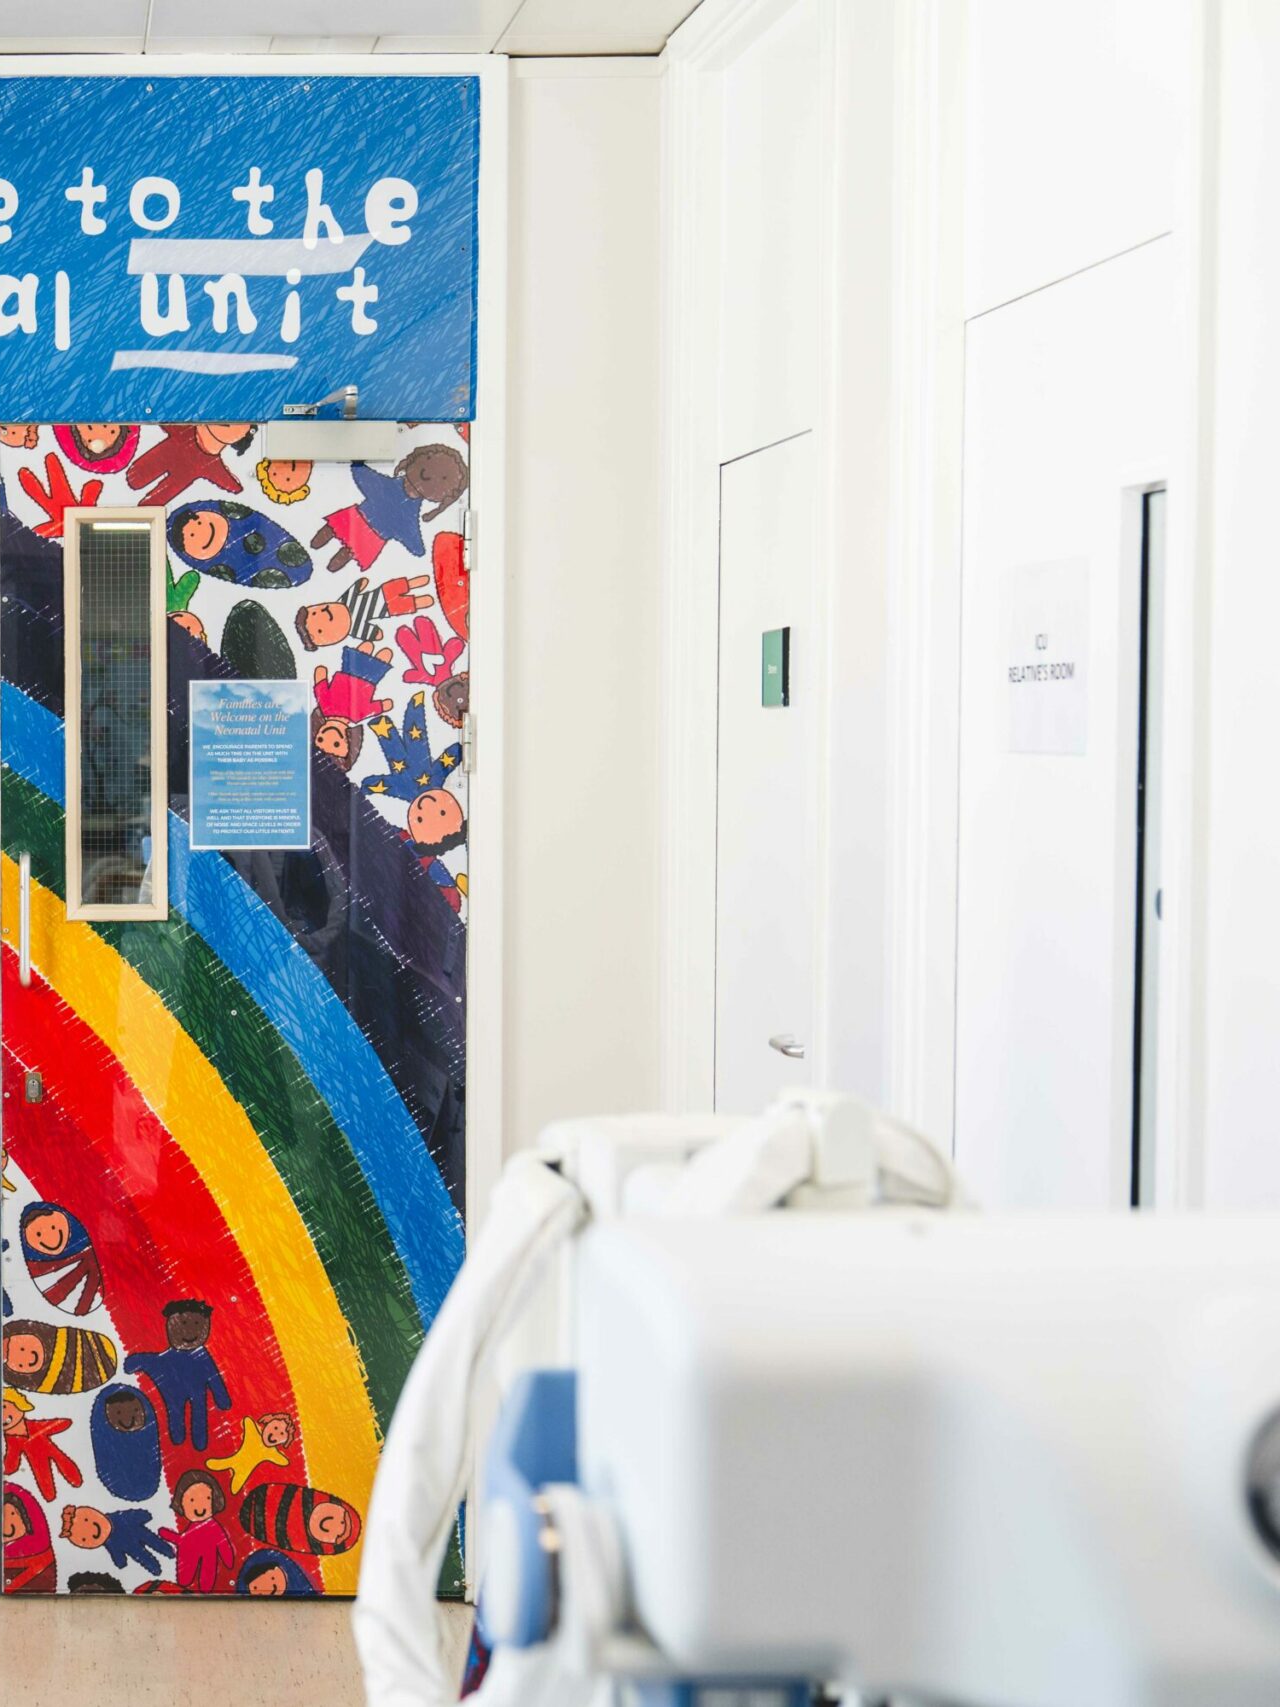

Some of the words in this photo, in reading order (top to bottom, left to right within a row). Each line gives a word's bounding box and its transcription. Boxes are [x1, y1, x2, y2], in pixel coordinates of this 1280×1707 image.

[65, 167, 180, 236] to
[232, 167, 419, 250] the
[140, 267, 379, 343] unit
[1050, 662, 1075, 680] ROOM
[217, 698, 262, 709] Families
[264, 701, 282, 709] are
[210, 711, 256, 722] Welcome
[259, 714, 272, 722] on
[274, 711, 290, 722] the
[214, 724, 261, 736] Neonatal
[264, 724, 287, 736] Unit
